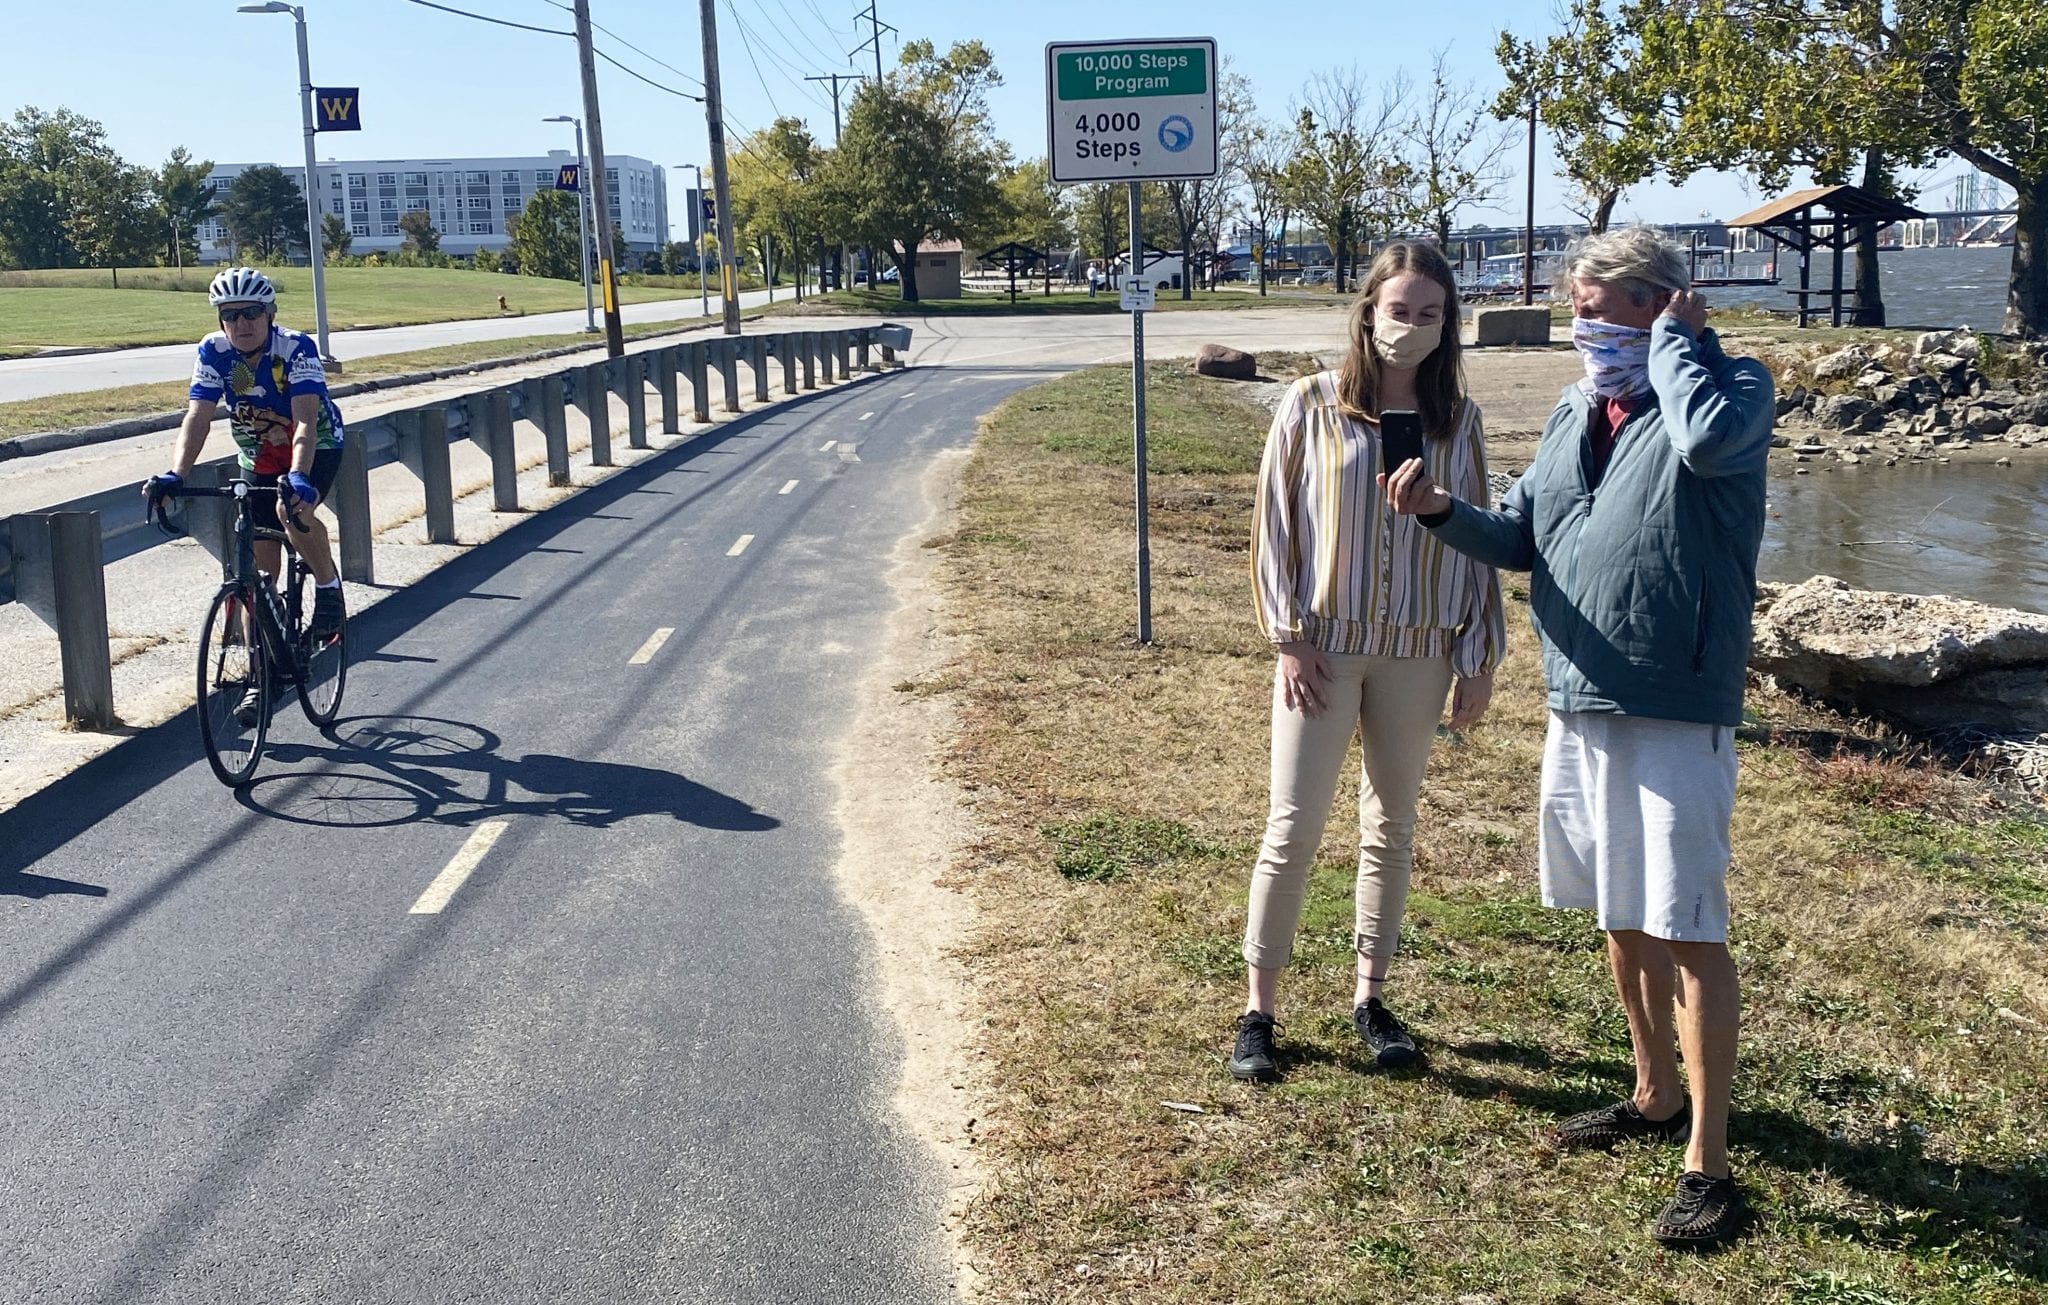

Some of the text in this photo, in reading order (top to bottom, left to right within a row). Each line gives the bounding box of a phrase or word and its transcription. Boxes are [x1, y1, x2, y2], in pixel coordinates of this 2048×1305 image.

[1075, 54, 1188, 72] 10,000 Steps
[1095, 76, 1169, 93] Program
[321, 97, 353, 121] W
[1075, 112, 1141, 137] 4,000
[1075, 139, 1141, 162] Steps
[561, 170, 576, 185] W
